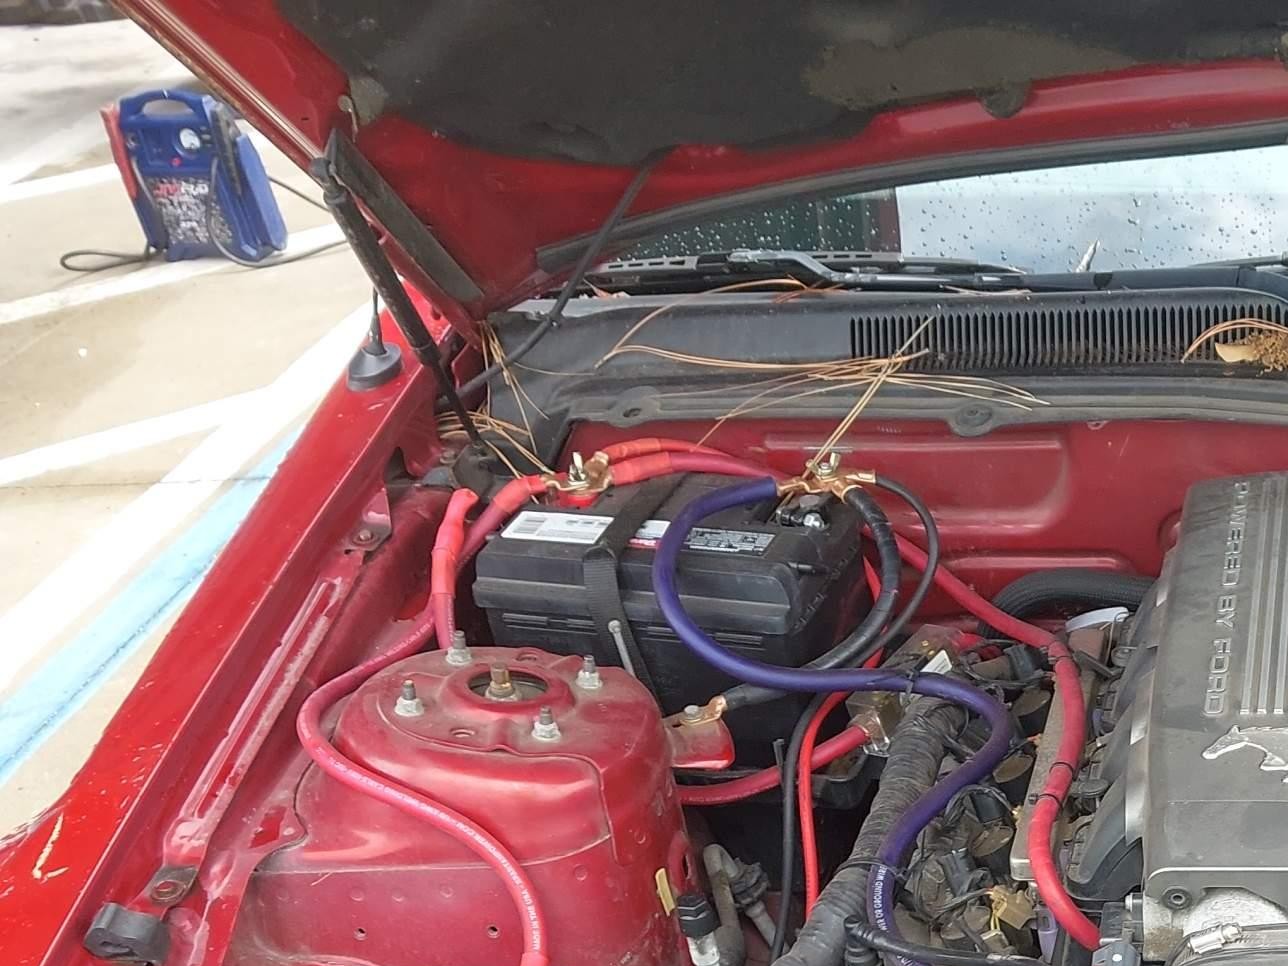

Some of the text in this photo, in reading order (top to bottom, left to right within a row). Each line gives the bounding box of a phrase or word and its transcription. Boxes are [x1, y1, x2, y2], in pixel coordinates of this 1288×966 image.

[1203, 480, 1250, 716] POWERED BY FORD
[521, 889, 534, 905] USA
[874, 881, 885, 908] GROUND
[875, 908, 884, 919] OR
